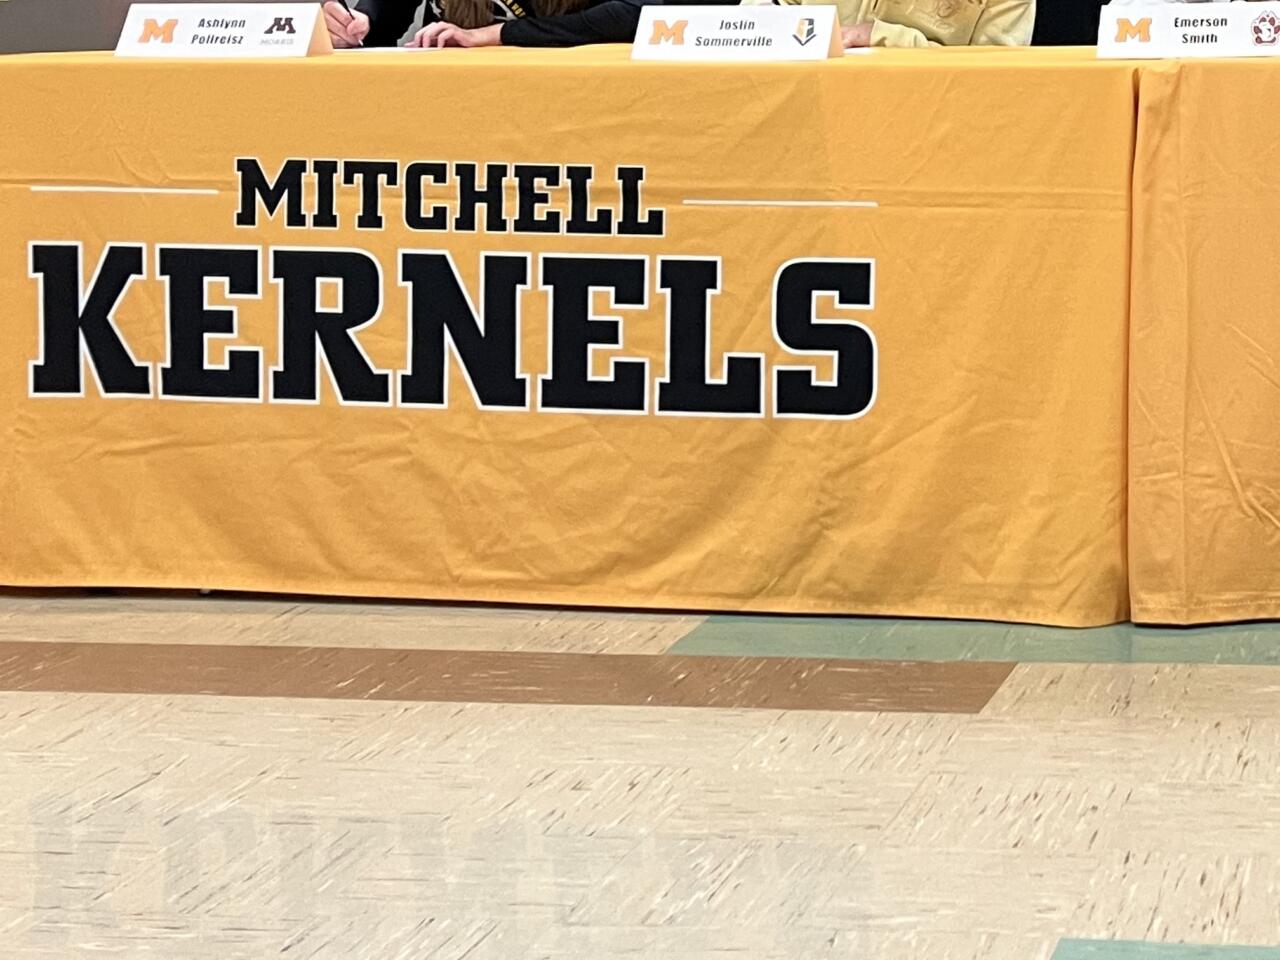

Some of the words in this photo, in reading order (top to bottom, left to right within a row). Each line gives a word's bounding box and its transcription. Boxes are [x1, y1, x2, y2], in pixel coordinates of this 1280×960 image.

[197, 17, 246, 29] Ashlynn
[719, 19, 755, 31] Joslin
[1174, 16, 1228, 28] Emerson
[137, 18, 179, 44] M
[648, 19, 688, 46] M
[1114, 17, 1152, 43] M
[190, 34, 244, 45] Pollreisz
[695, 36, 773, 47] Sommerville
[1181, 33, 1218, 44] Smith
[233, 156, 666, 237] MITCHELL
[28, 240, 880, 420] KERNELS
